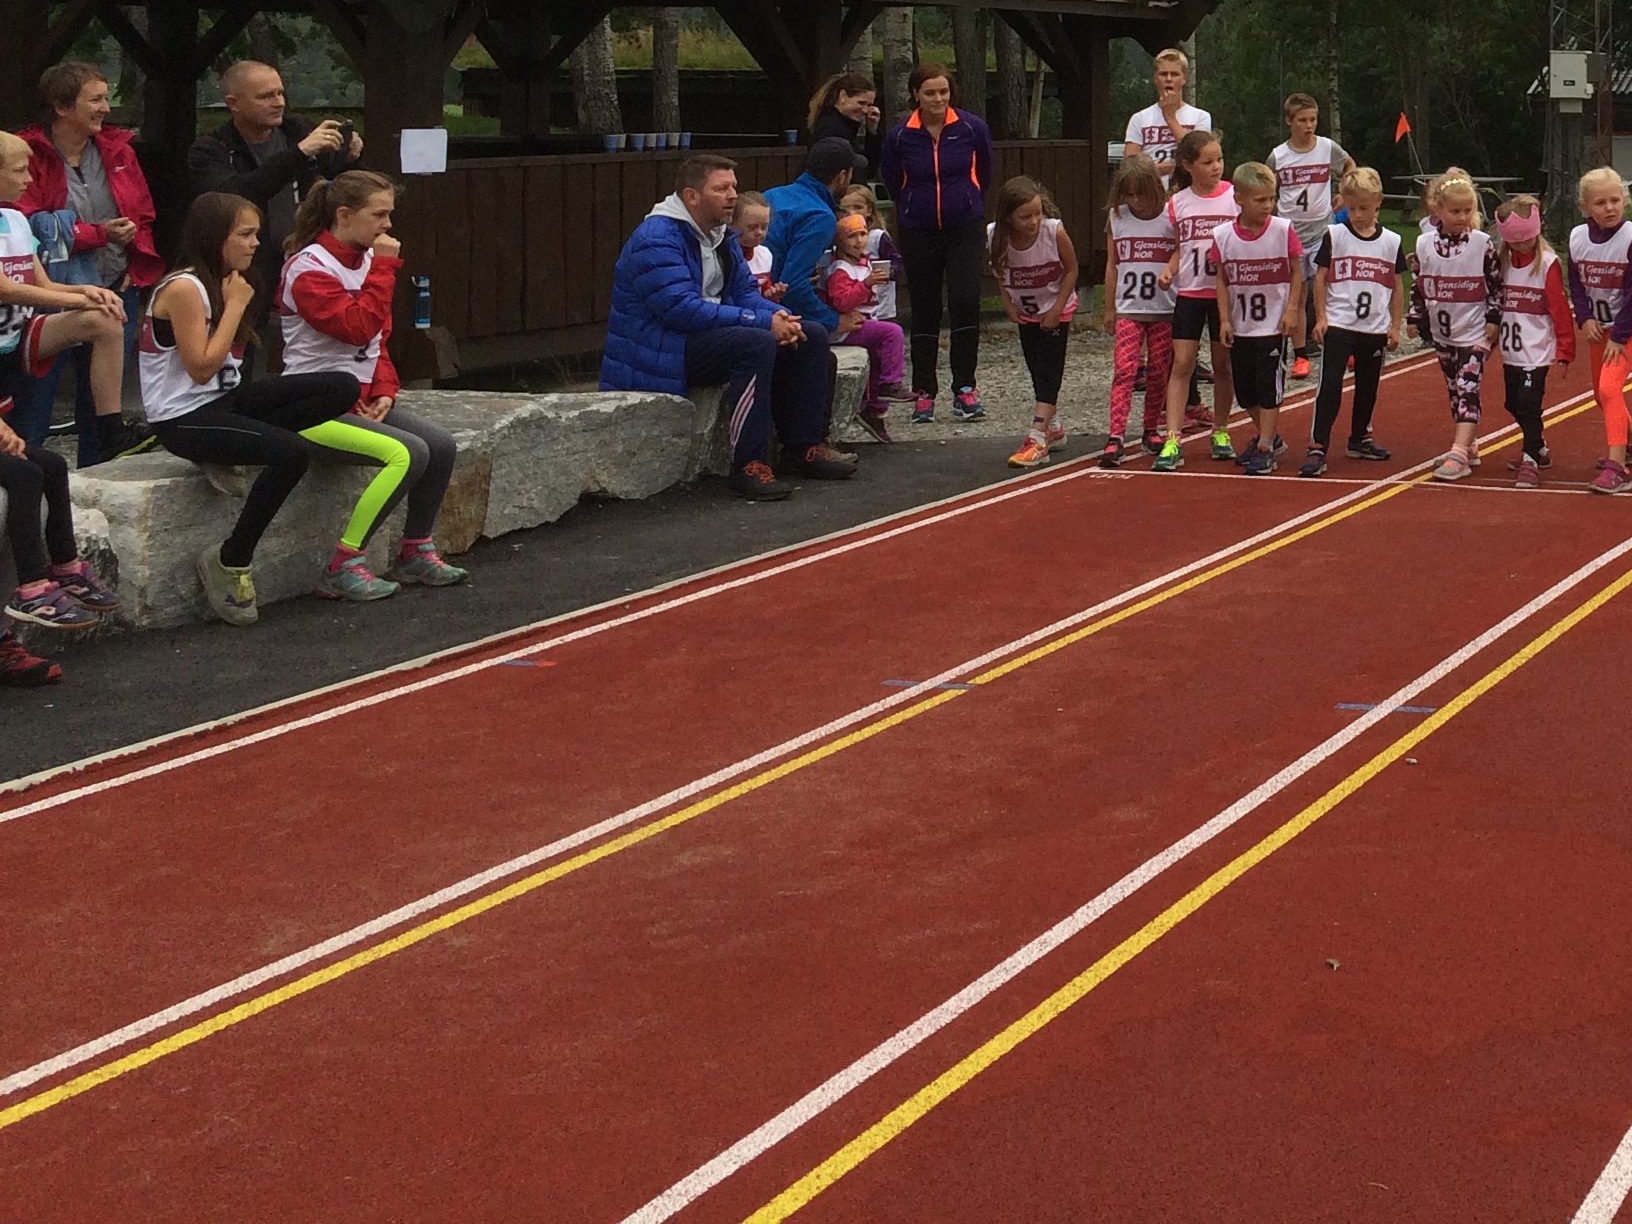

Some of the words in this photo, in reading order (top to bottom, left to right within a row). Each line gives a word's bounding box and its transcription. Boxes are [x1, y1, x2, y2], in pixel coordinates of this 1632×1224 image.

[1296, 189, 1308, 212] 4
[1239, 263, 1283, 274] Gjensidige
[1239, 274, 1259, 282] NOR
[1355, 270, 1375, 279] NOR
[1122, 271, 1157, 300] 28
[1020, 295, 1040, 315] 5
[1237, 292, 1267, 322] 18
[1356, 291, 1372, 320] 8
[1437, 310, 1451, 338] 9
[1500, 321, 1523, 352] 26
